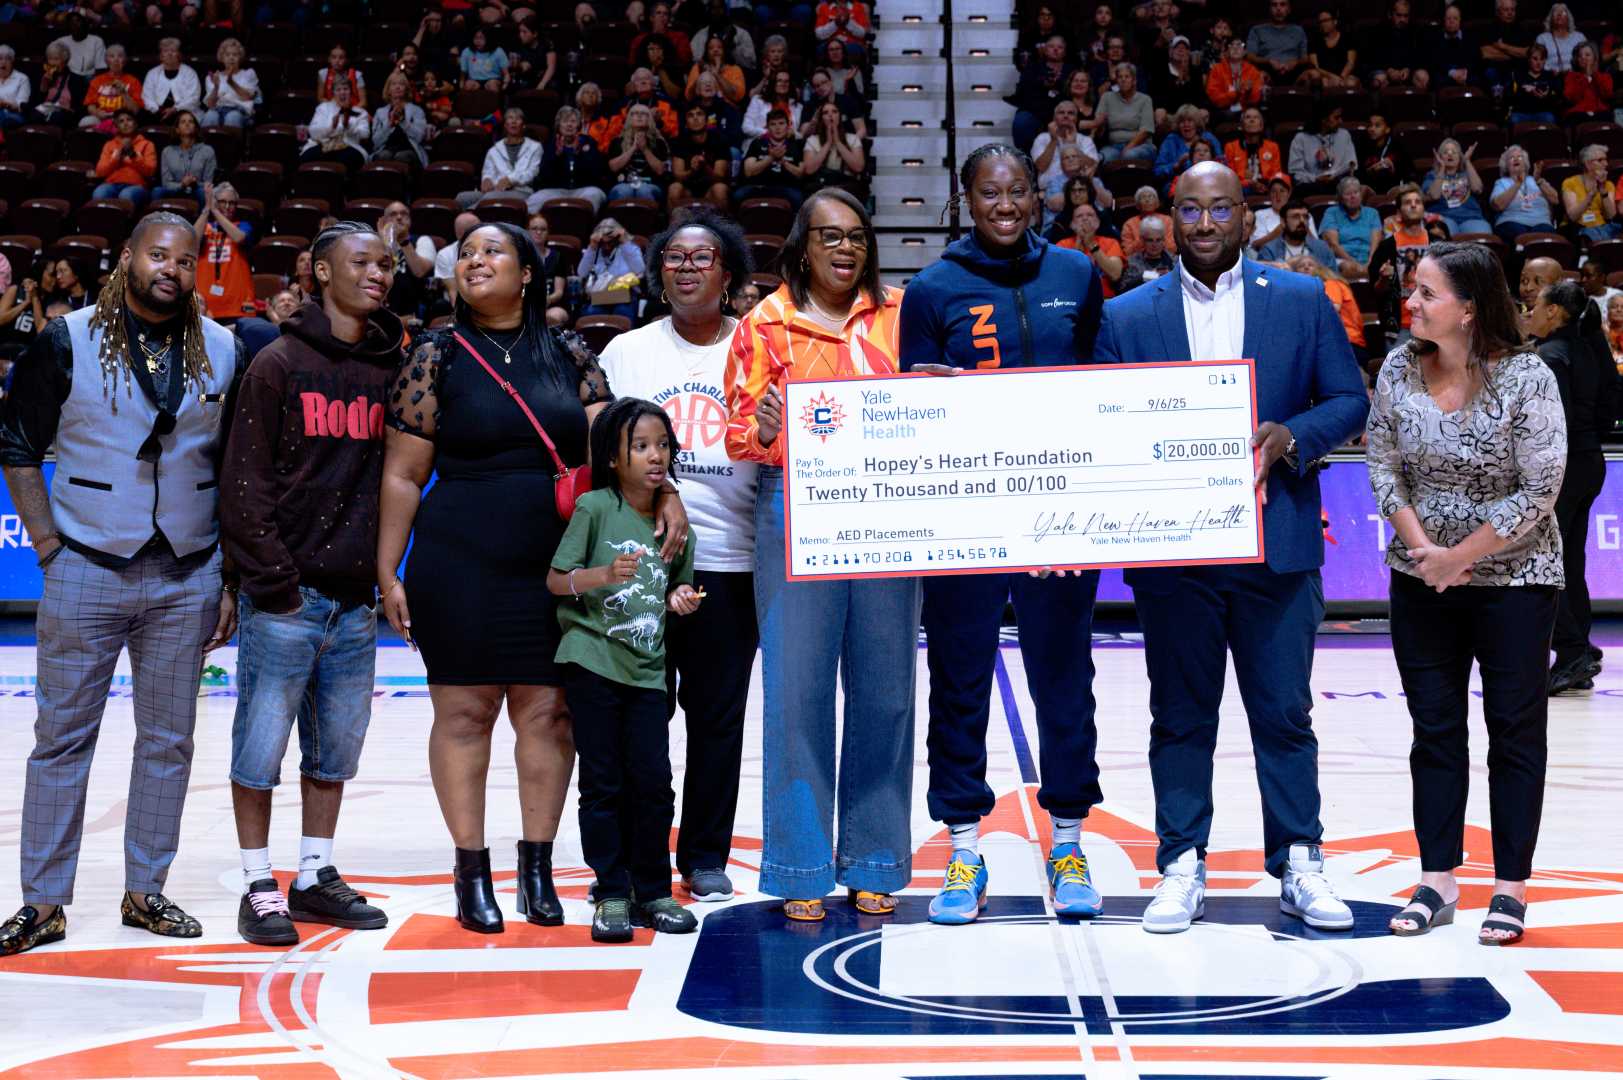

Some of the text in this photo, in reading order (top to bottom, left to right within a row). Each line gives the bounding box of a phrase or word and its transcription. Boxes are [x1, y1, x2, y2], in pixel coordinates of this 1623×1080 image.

[652, 385, 681, 403] TINA
[861, 389, 892, 405] Yale
[1098, 397, 1187, 413] Date: 9/6/25
[862, 405, 946, 422] NewHaven
[863, 424, 916, 439] Health
[681, 451, 695, 462] 31
[1167, 442, 1240, 458] 20,000.00
[680, 463, 734, 477] THANKS
[796, 457, 824, 469] Pay To
[864, 449, 1093, 475] Hopey's Heart Foundation
[796, 467, 857, 478] The Order Of:
[806, 475, 1067, 502] Twenty Thousand and 00/100
[1208, 476, 1243, 487] Dollars
[1033, 504, 1250, 543] Yale New Haven Health
[799, 527, 935, 546] Memo: AED Placements
[1090, 533, 1192, 545] Yale New Haven Health
